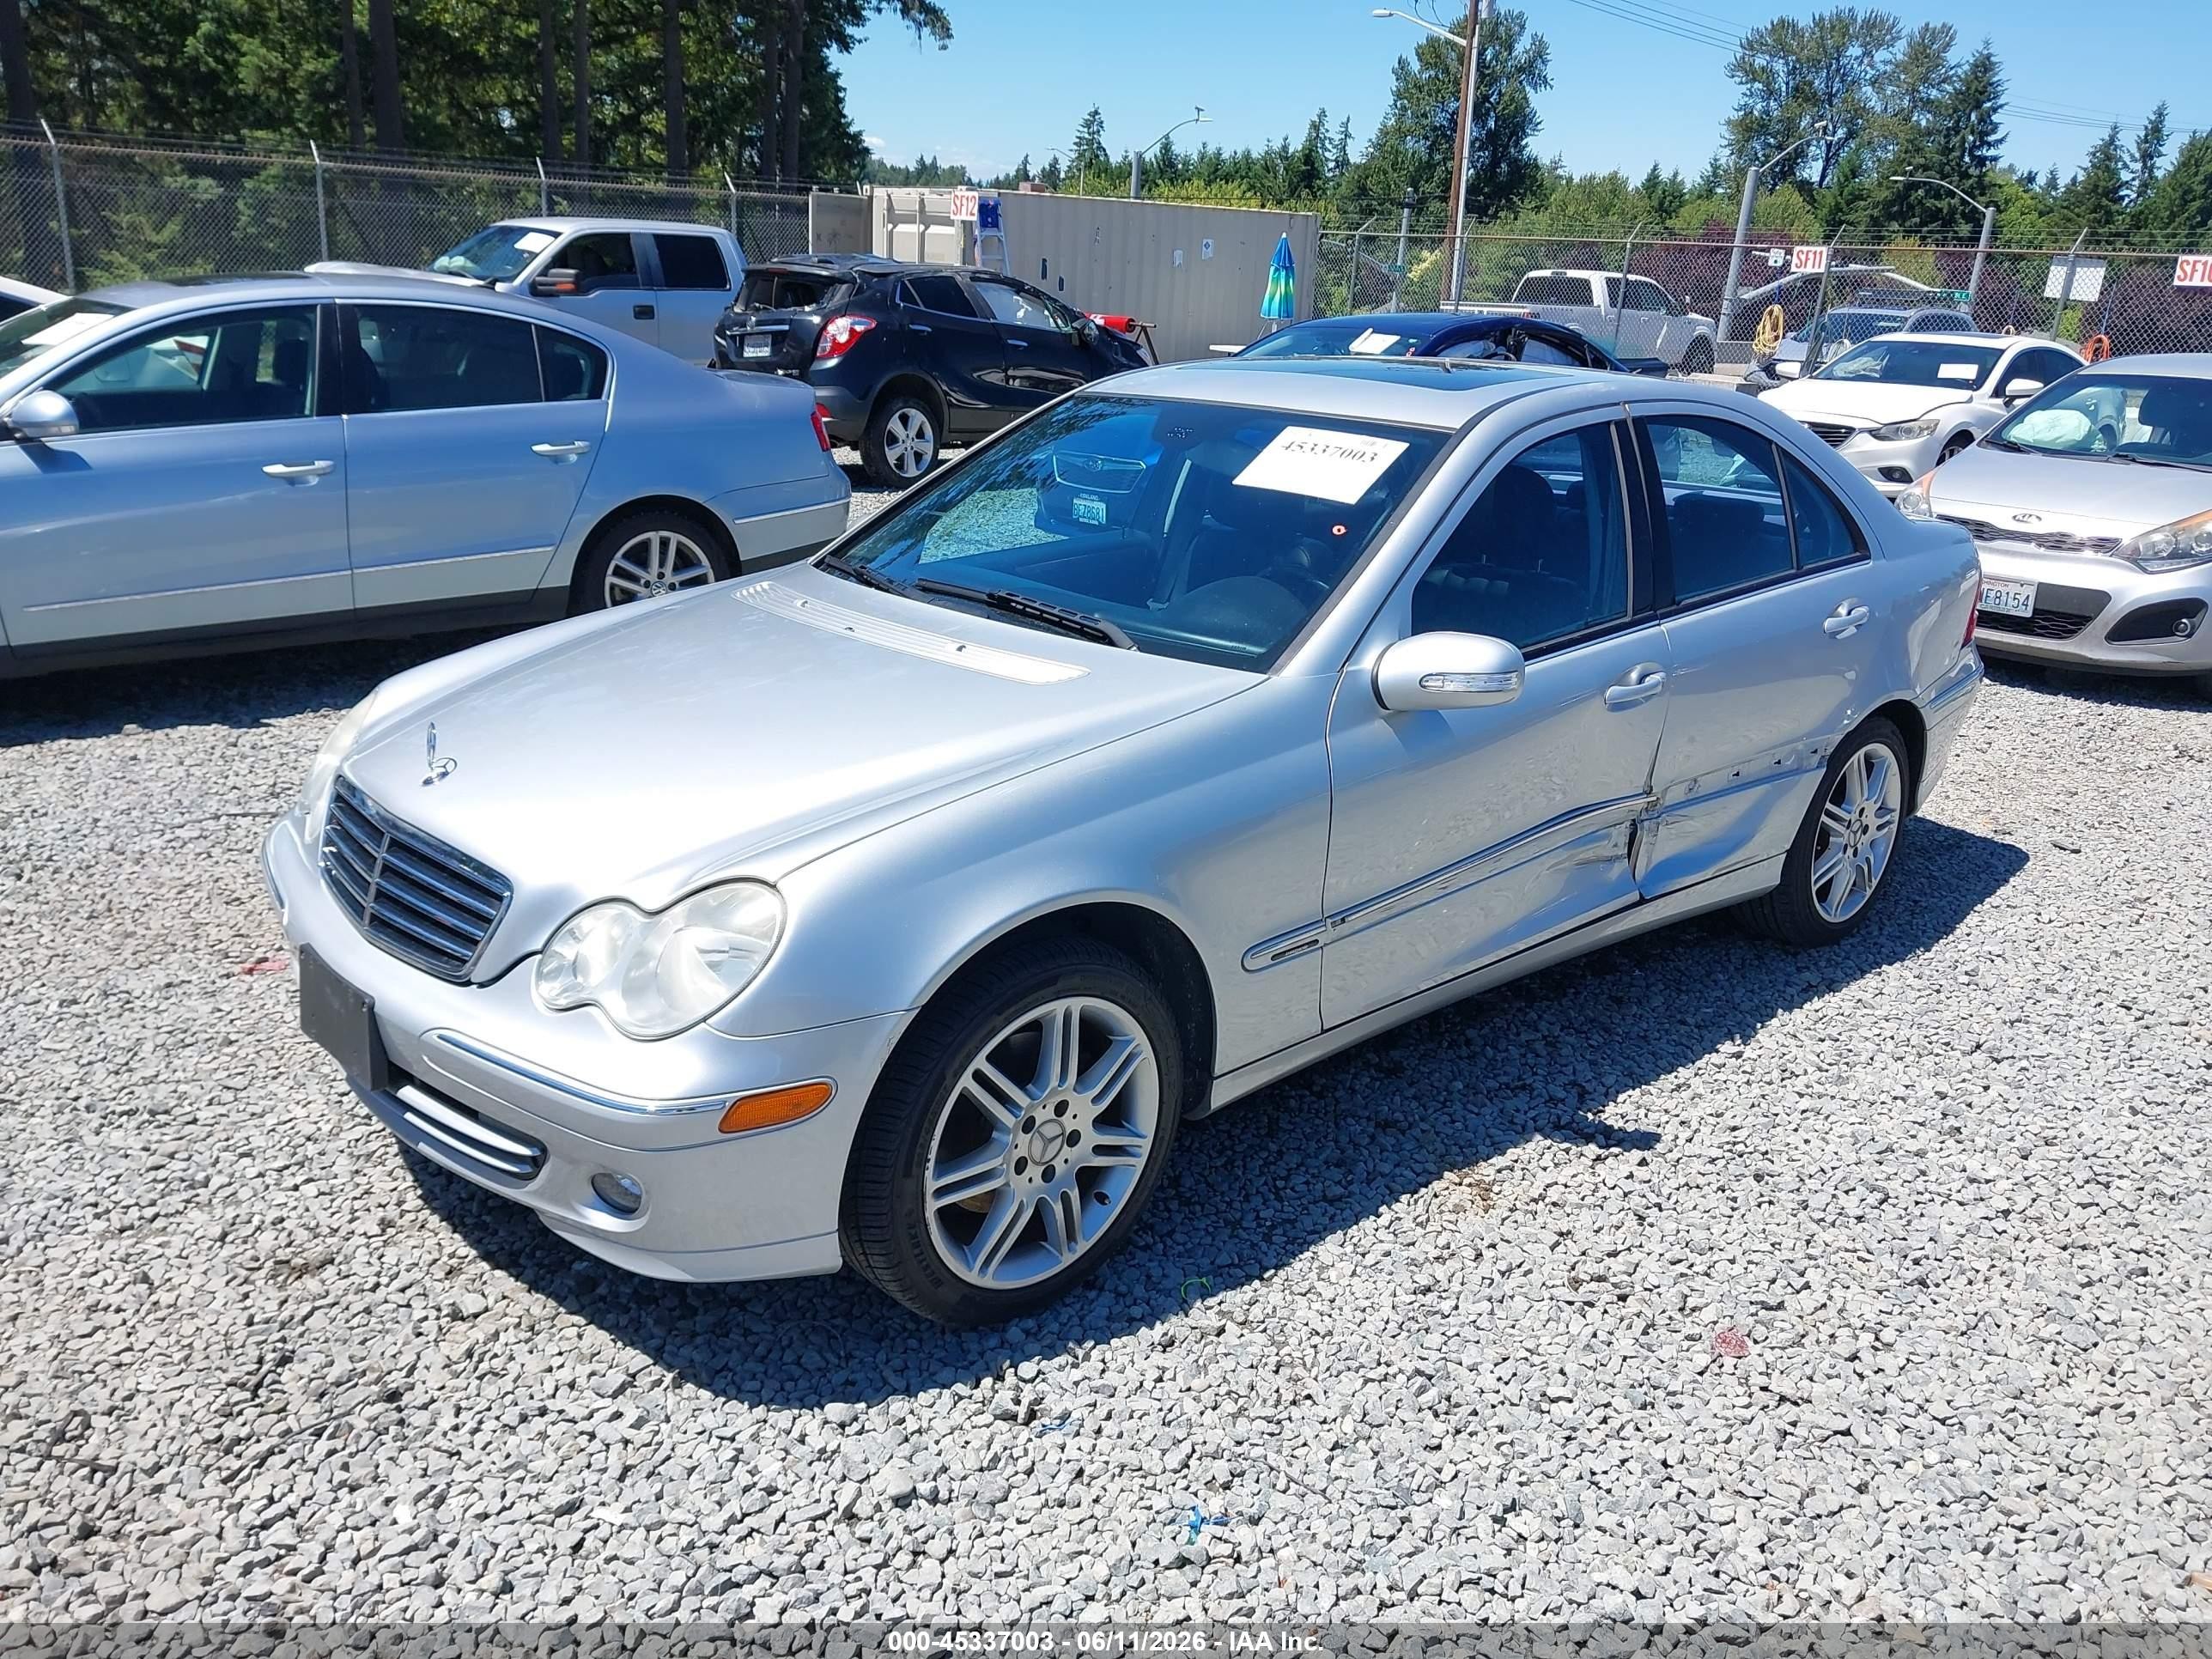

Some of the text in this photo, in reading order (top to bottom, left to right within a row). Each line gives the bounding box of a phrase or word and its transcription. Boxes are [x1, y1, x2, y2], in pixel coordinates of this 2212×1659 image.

[952, 194, 976, 216] SF12
[1795, 250, 1823, 269] SF11
[1281, 440, 1378, 464] 45337003
